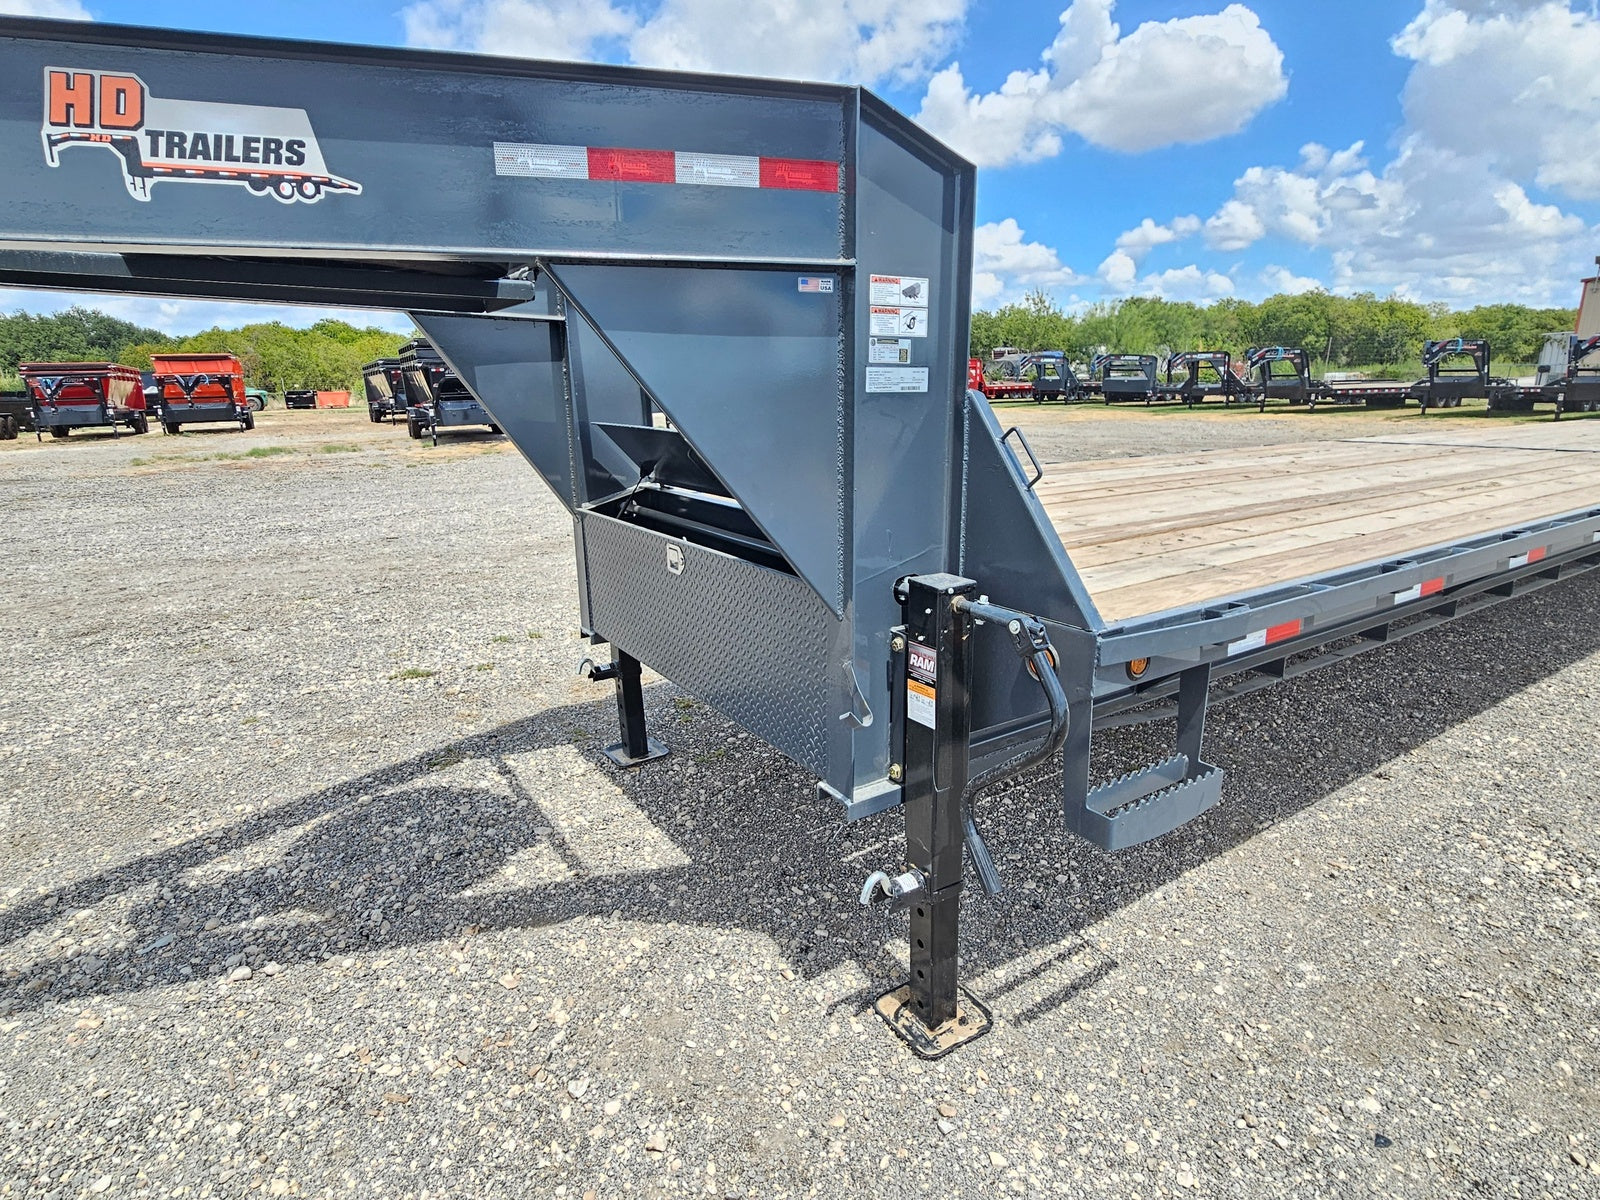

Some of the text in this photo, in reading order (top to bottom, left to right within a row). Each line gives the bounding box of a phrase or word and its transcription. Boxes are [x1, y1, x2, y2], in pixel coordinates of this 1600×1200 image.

[50, 71, 144, 131] HD
[90, 133, 112, 143] HD
[145, 129, 305, 166] TRAILERS
[910, 653, 934, 672] RAM
